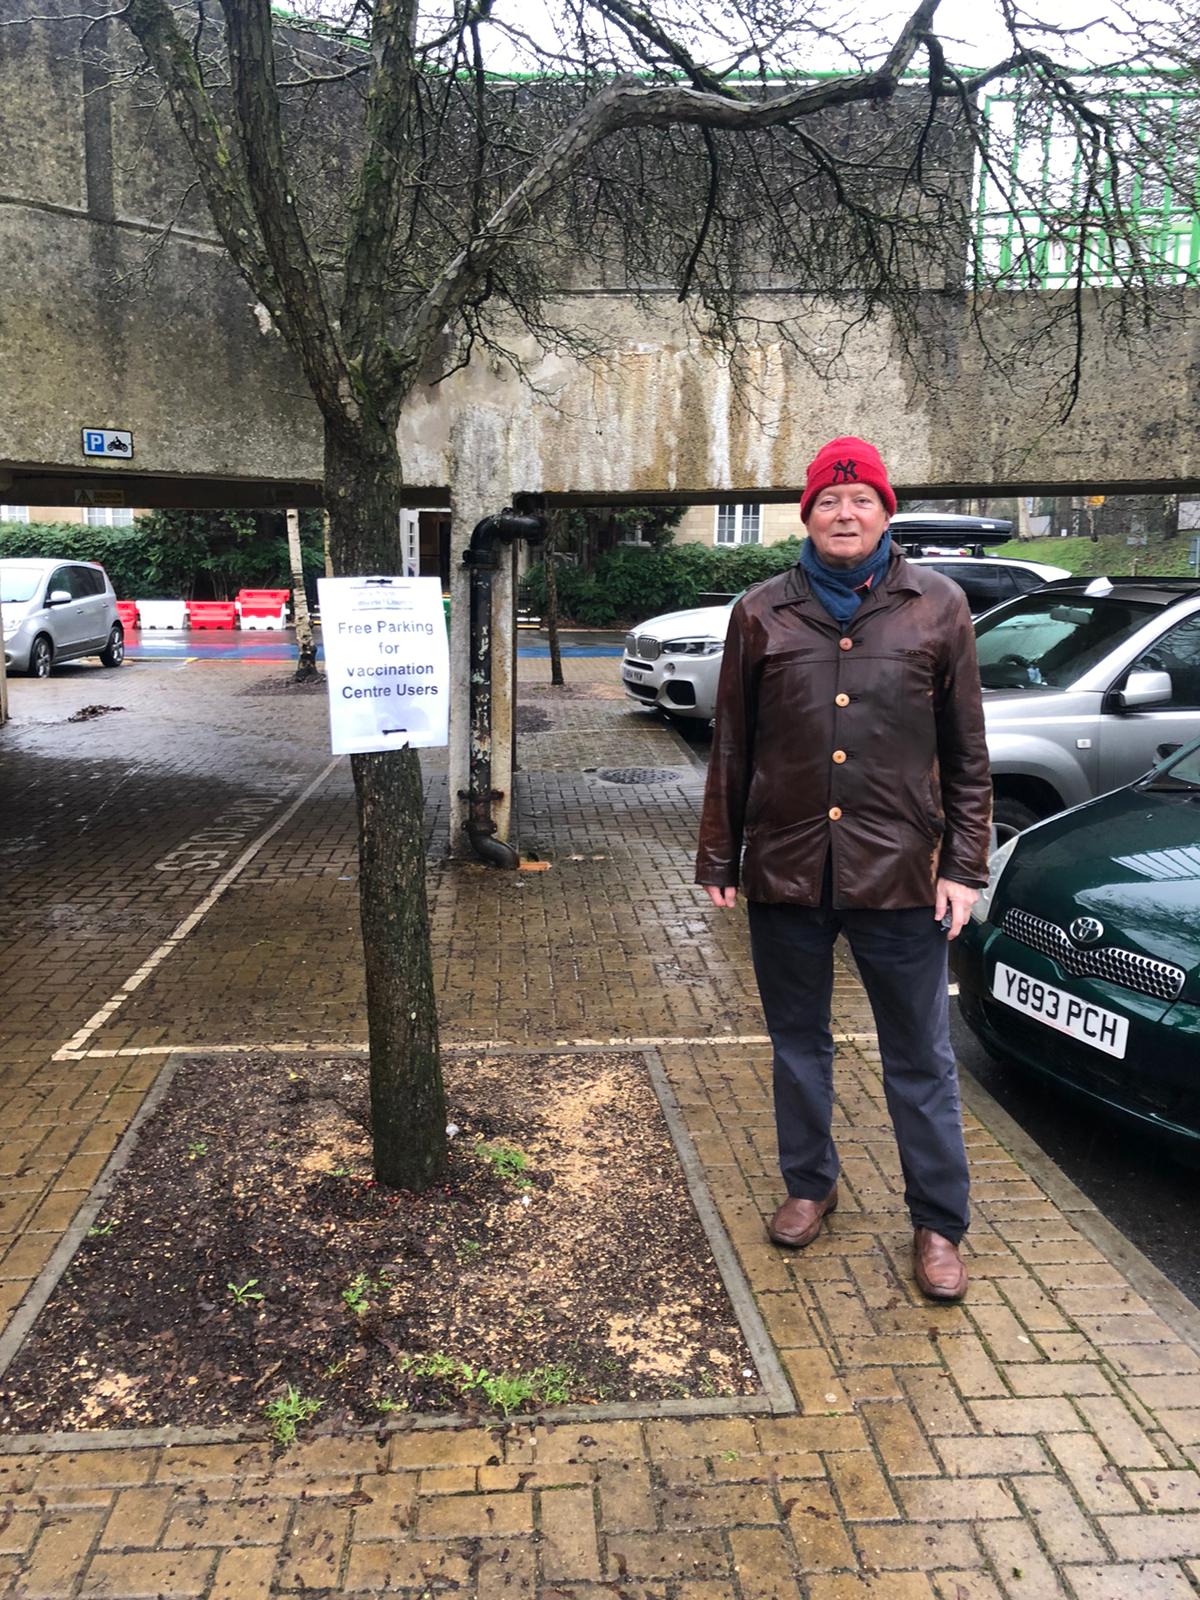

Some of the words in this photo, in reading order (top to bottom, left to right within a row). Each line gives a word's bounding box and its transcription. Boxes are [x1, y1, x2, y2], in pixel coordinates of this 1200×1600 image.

[90, 434, 102, 450] P
[832, 459, 858, 482] NY
[338, 622, 372, 634] Free
[377, 620, 433, 635] Parking
[378, 642, 400, 654] for
[342, 685, 391, 699] Centre
[396, 684, 438, 697] Users
[1005, 969, 1060, 1020] Y893
[1066, 999, 1118, 1047] PCH
